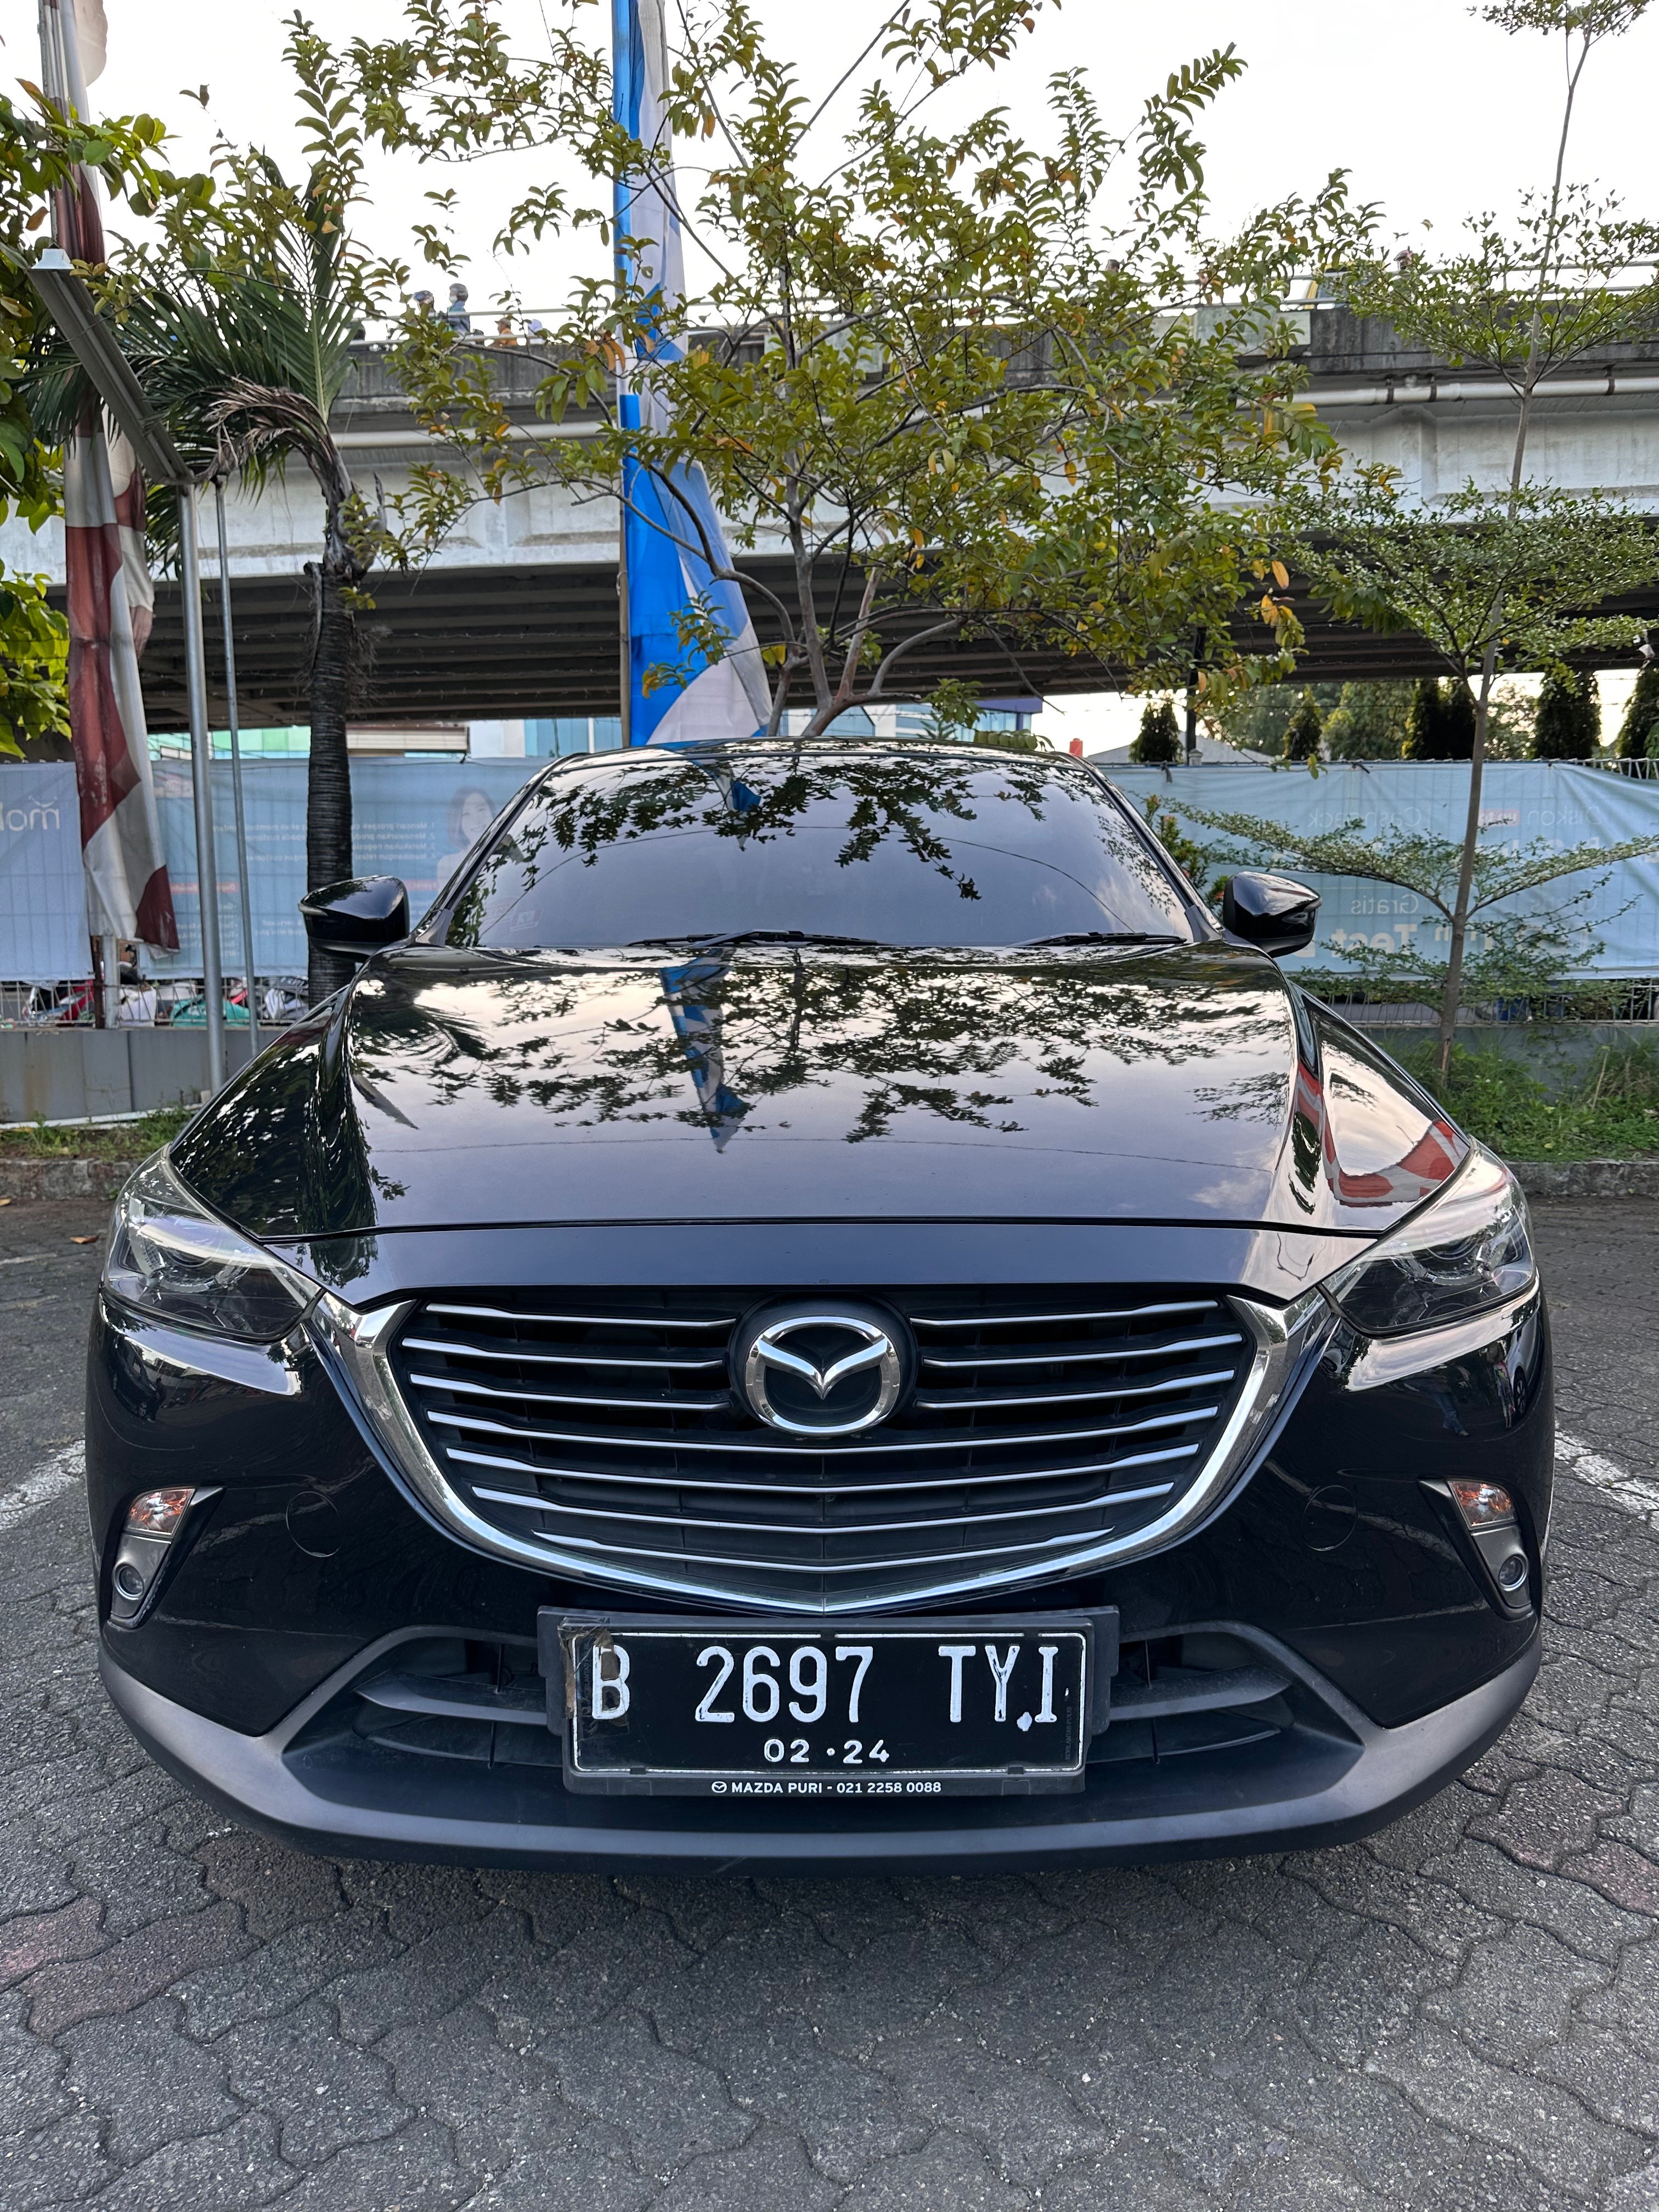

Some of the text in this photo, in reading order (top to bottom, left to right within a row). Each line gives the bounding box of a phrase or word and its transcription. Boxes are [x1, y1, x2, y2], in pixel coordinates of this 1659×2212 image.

[592, 1644, 1059, 1723] B 2697 TYI
[731, 1782, 783, 1793] MAZDA
[788, 1782, 822, 1793] PURI
[836, 1782, 863, 1793] 021
[867, 1782, 902, 1793] 2258
[906, 1781, 941, 1793] 0088
